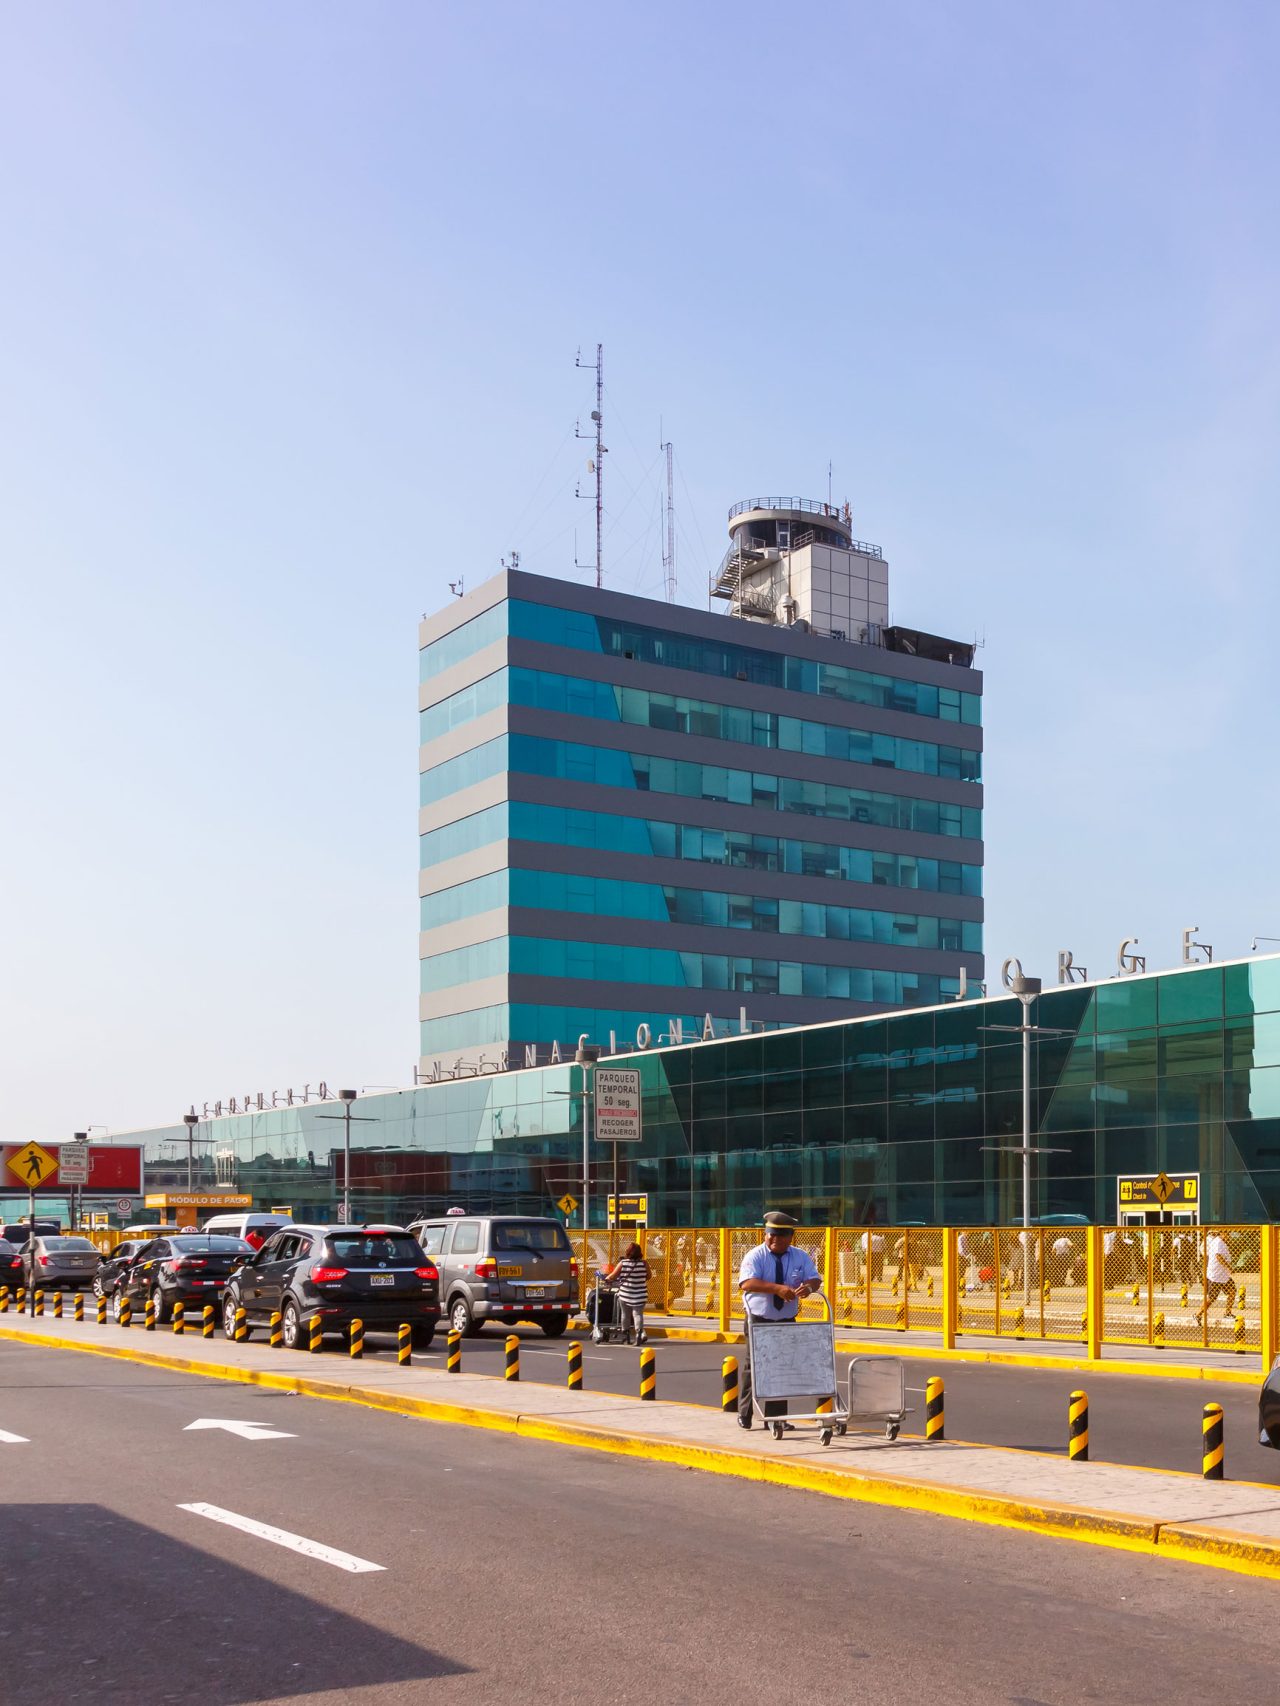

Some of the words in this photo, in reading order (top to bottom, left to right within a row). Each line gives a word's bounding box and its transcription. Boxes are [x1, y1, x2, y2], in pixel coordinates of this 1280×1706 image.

[413, 1006, 750, 1085] INTERNACIONAL
[955, 926, 1199, 1000] JORGE
[600, 1073, 635, 1083] PARQUEO
[598, 1084, 638, 1094] TEMPORAL
[604, 1096, 613, 1106] 50
[617, 1099, 632, 1109] seg.
[602, 1119, 634, 1127] RECOGER
[600, 1128, 637, 1136] PASAJEROS
[1187, 1182, 1193, 1196] 7
[169, 1196, 208, 1204] MÓDULO
